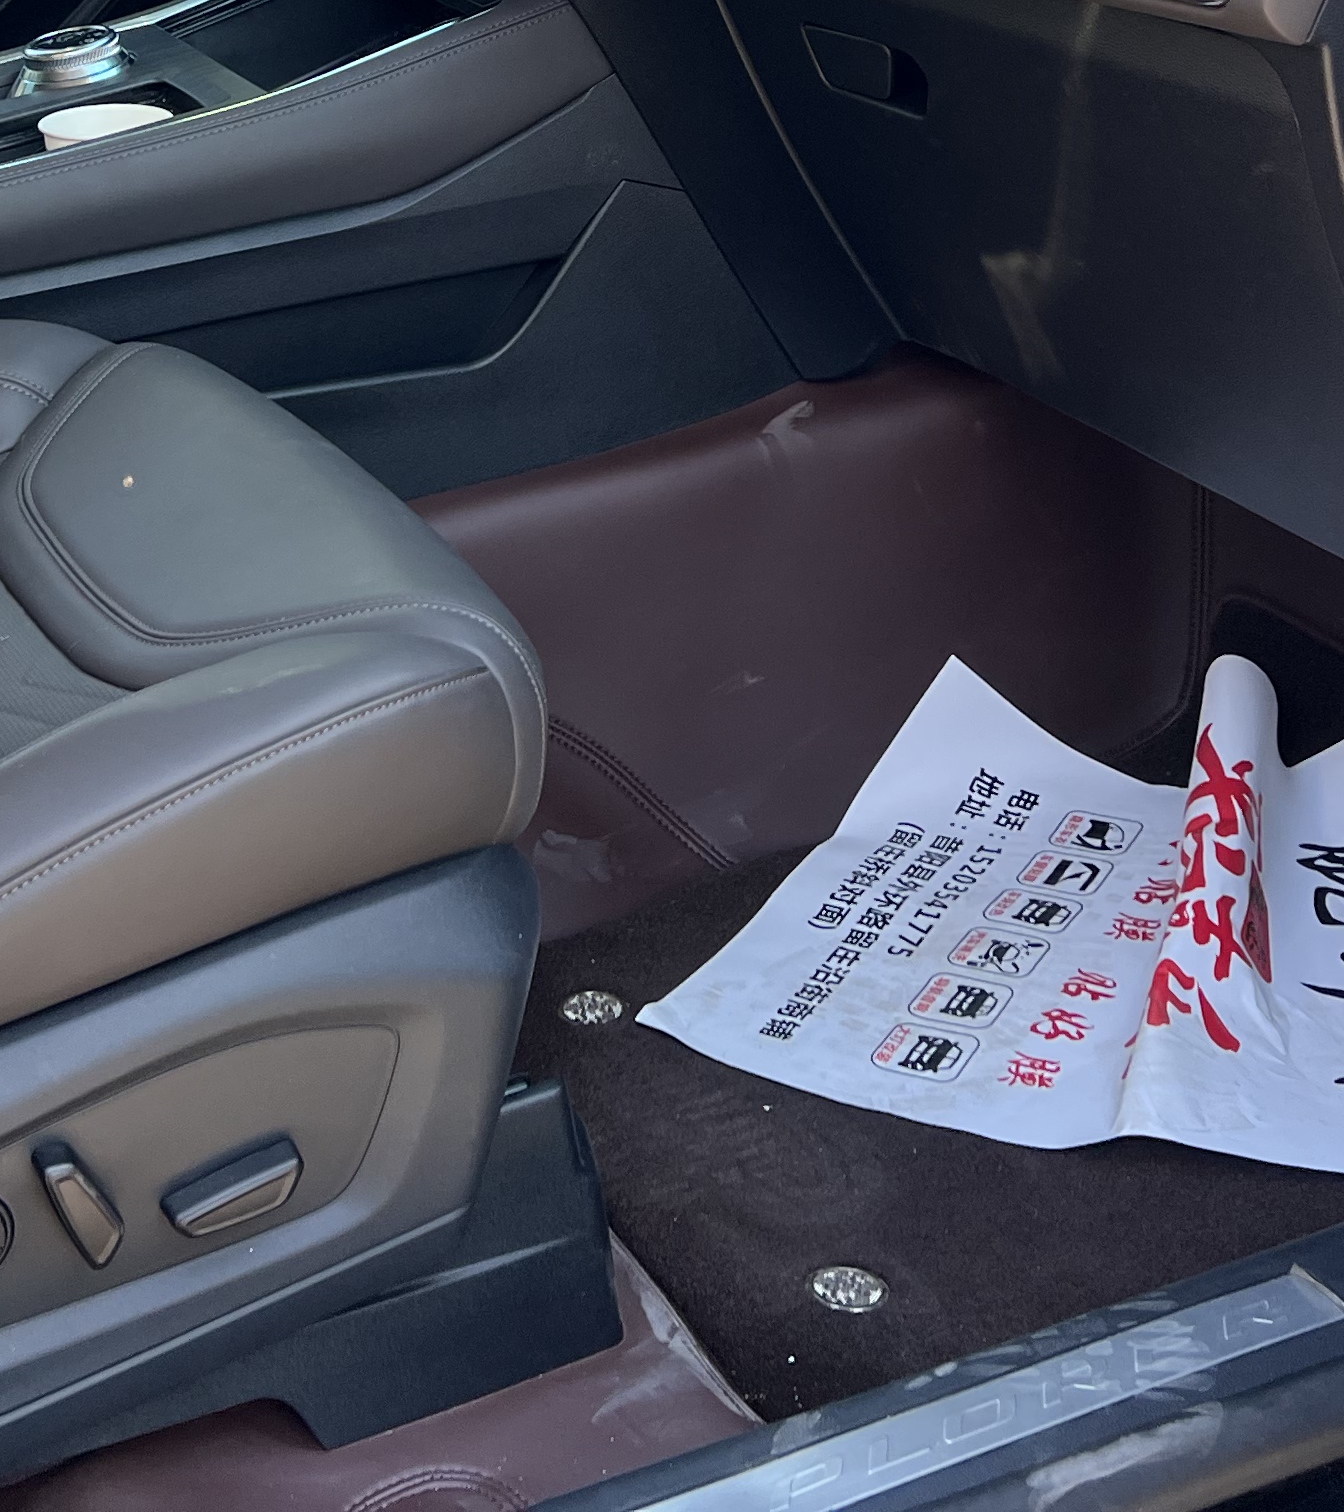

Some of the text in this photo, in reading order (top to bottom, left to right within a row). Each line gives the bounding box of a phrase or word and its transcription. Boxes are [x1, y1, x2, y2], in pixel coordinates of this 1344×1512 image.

[874, 1025, 912, 1064] 大灯改装
[997, 968, 1118, 1088] 贴好膜
